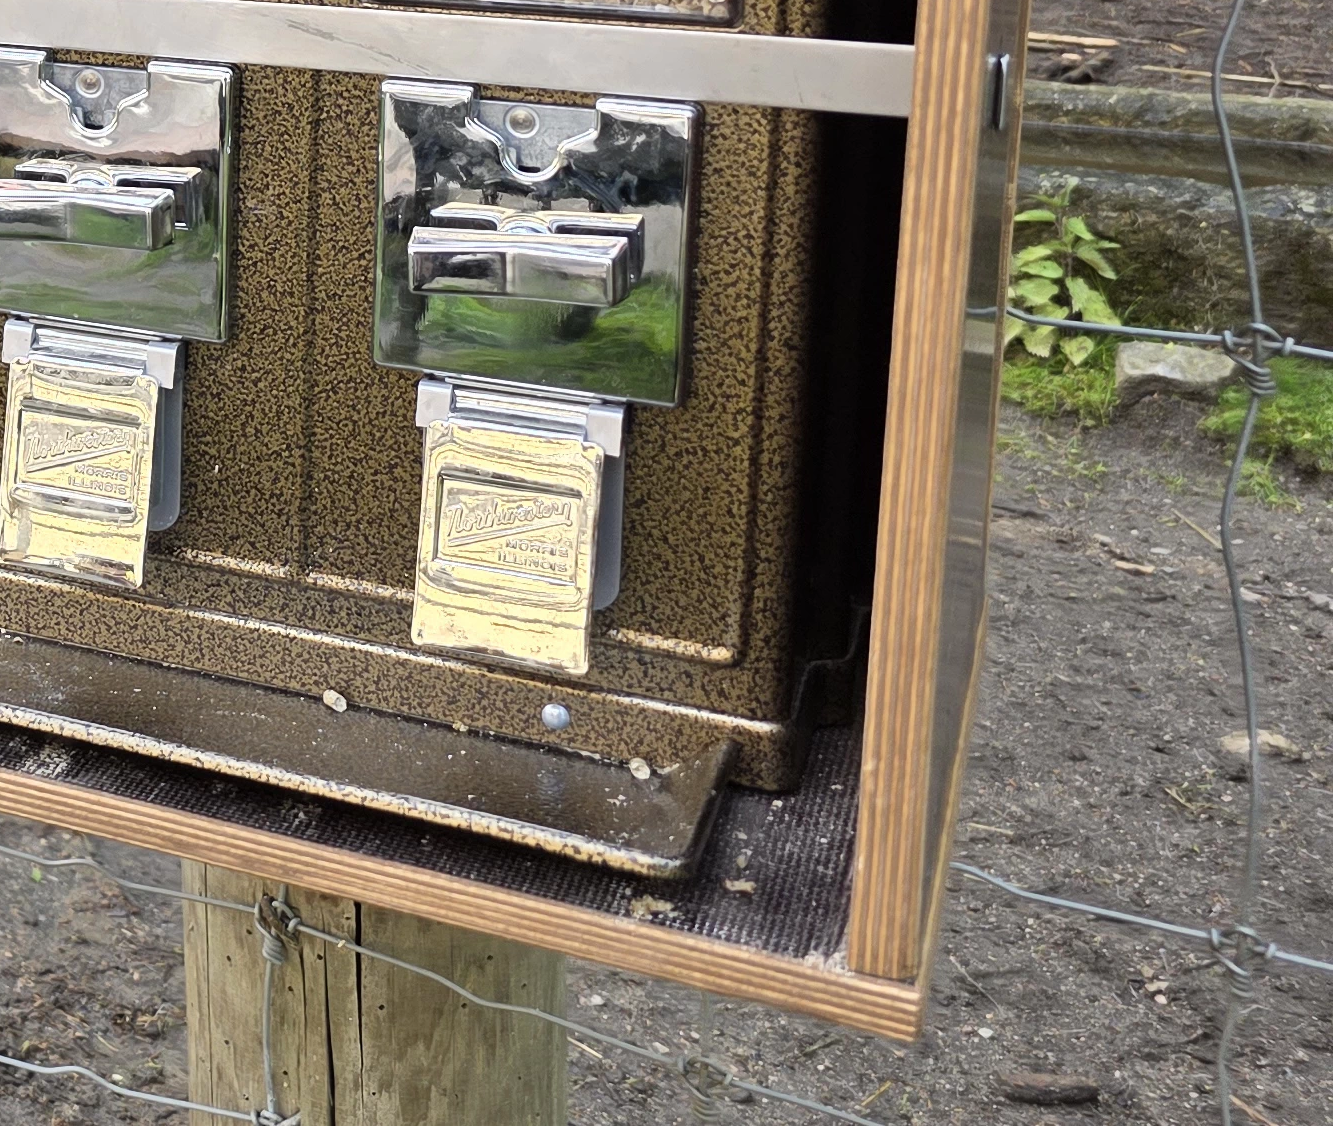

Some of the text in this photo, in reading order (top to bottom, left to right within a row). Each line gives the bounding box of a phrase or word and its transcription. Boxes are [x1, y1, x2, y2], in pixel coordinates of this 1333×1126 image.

[74, 464, 128, 482] MORRIS
[68, 476, 126, 495] ILLINOIS
[447, 497, 573, 538] Northwestern
[505, 539, 568, 558] MORRIS
[498, 551, 567, 572] ILLINOIS
